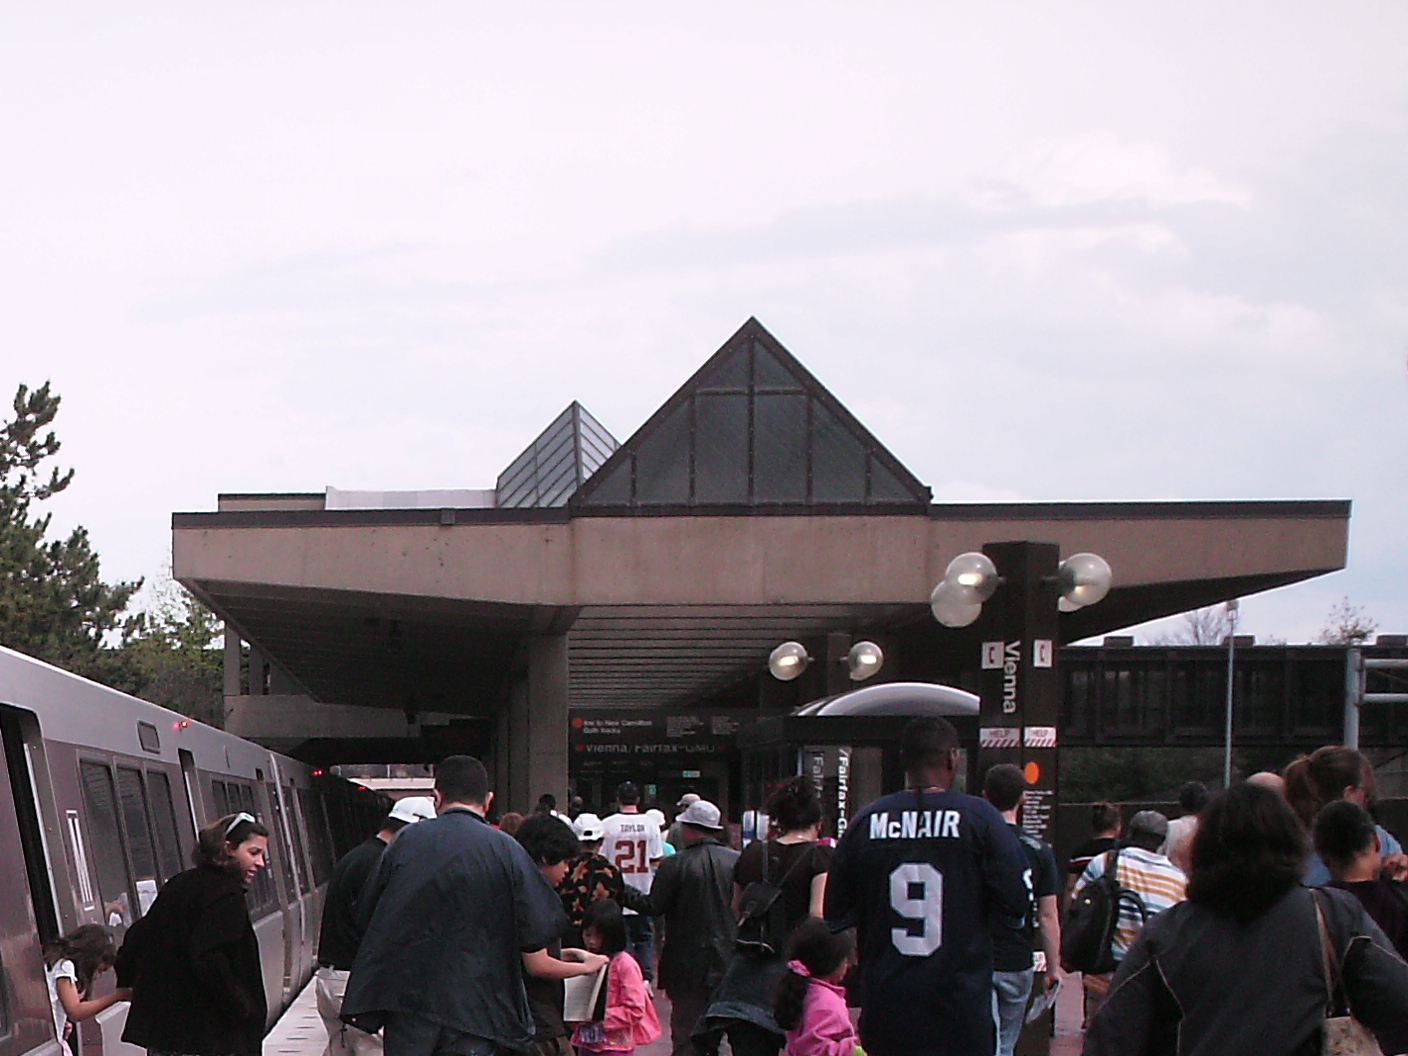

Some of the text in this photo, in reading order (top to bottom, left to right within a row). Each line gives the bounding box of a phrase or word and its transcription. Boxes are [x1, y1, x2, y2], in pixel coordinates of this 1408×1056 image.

[1003, 640, 1021, 714] Vienna
[869, 810, 961, 840] McNAIR
[615, 840, 649, 874] 21
[889, 863, 943, 957] 9
